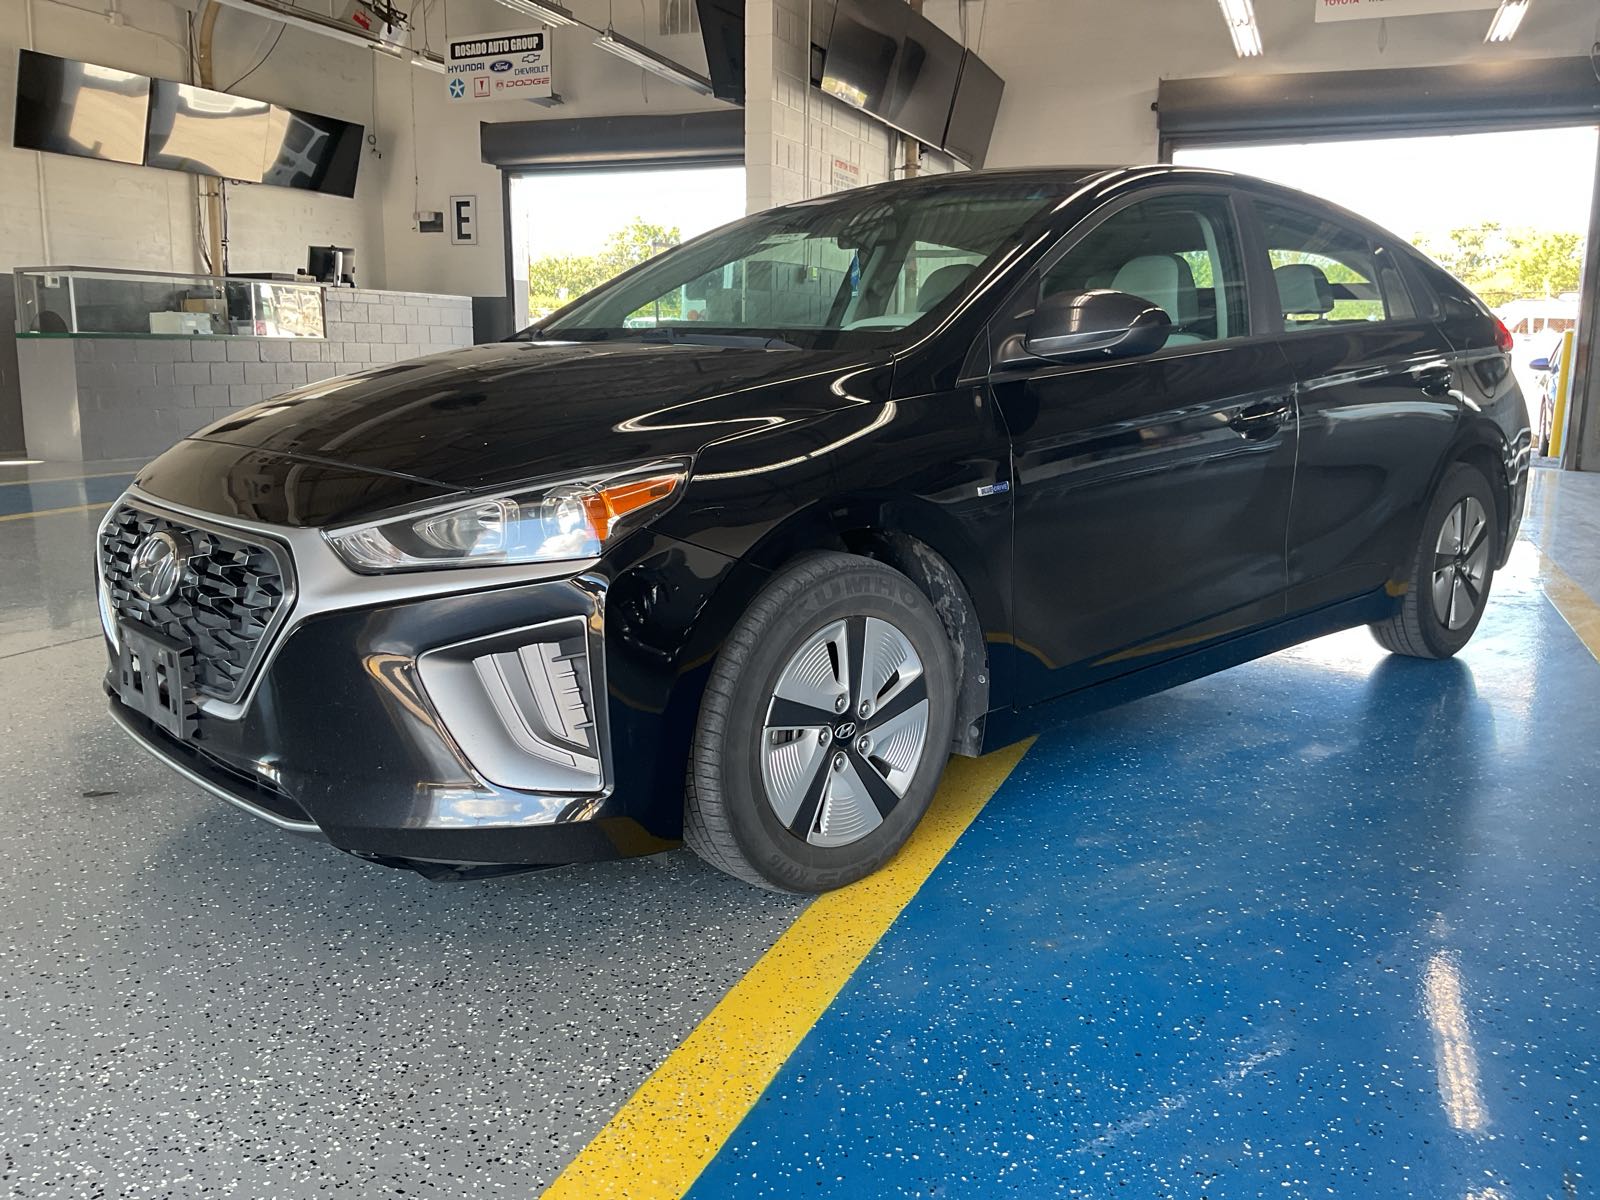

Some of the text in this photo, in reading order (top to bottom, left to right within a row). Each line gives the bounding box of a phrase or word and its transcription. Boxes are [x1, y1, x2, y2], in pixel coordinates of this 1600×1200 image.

[455, 36, 539, 57] ROSADO AUTO GROUP
[448, 62, 485, 74] HYUNDAI
[514, 65, 549, 76] CHEVROLET
[506, 77, 550, 88] DODGE
[456, 201, 471, 240] E
[792, 573, 922, 614] KUMHO
